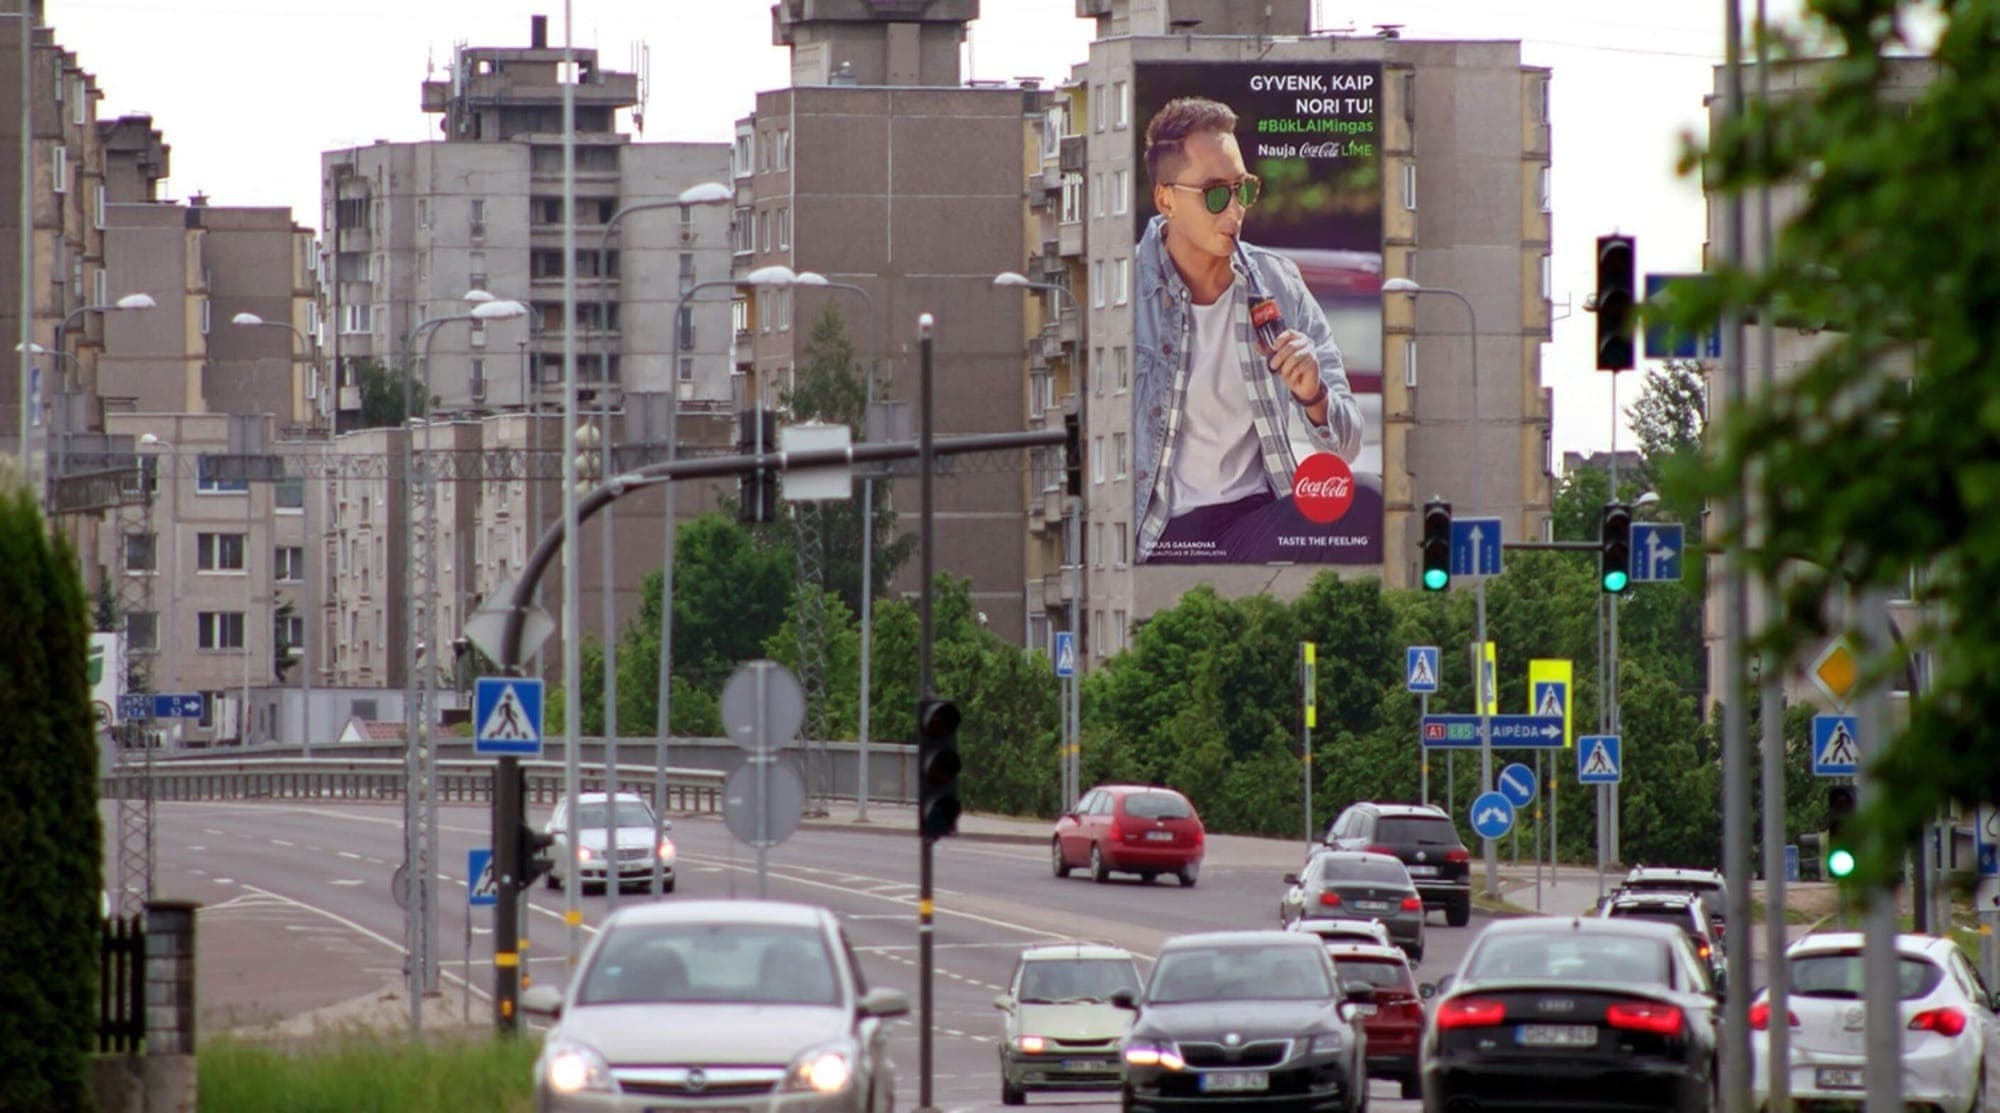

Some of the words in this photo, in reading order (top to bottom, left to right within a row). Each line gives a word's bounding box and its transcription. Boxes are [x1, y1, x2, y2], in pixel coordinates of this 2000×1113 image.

[1250, 75, 1327, 93] GYVENK,
[1332, 75, 1374, 90] KAIP
[1296, 98, 1340, 114] NORI
[1345, 98, 1373, 114] TU!
[1258, 119, 1374, 134] #BūkLAIMingas
[1258, 144, 1296, 158] Nauja
[1341, 141, 1372, 156] LIME
[1172, 541, 1216, 549] GASANOVAS
[1278, 536, 1306, 546] TASTE
[1308, 536, 1327, 546] THE
[1329, 536, 1369, 546] FEELING
[1429, 726, 1442, 738] A1
[1475, 723, 1540, 738] KAIPĖDA
